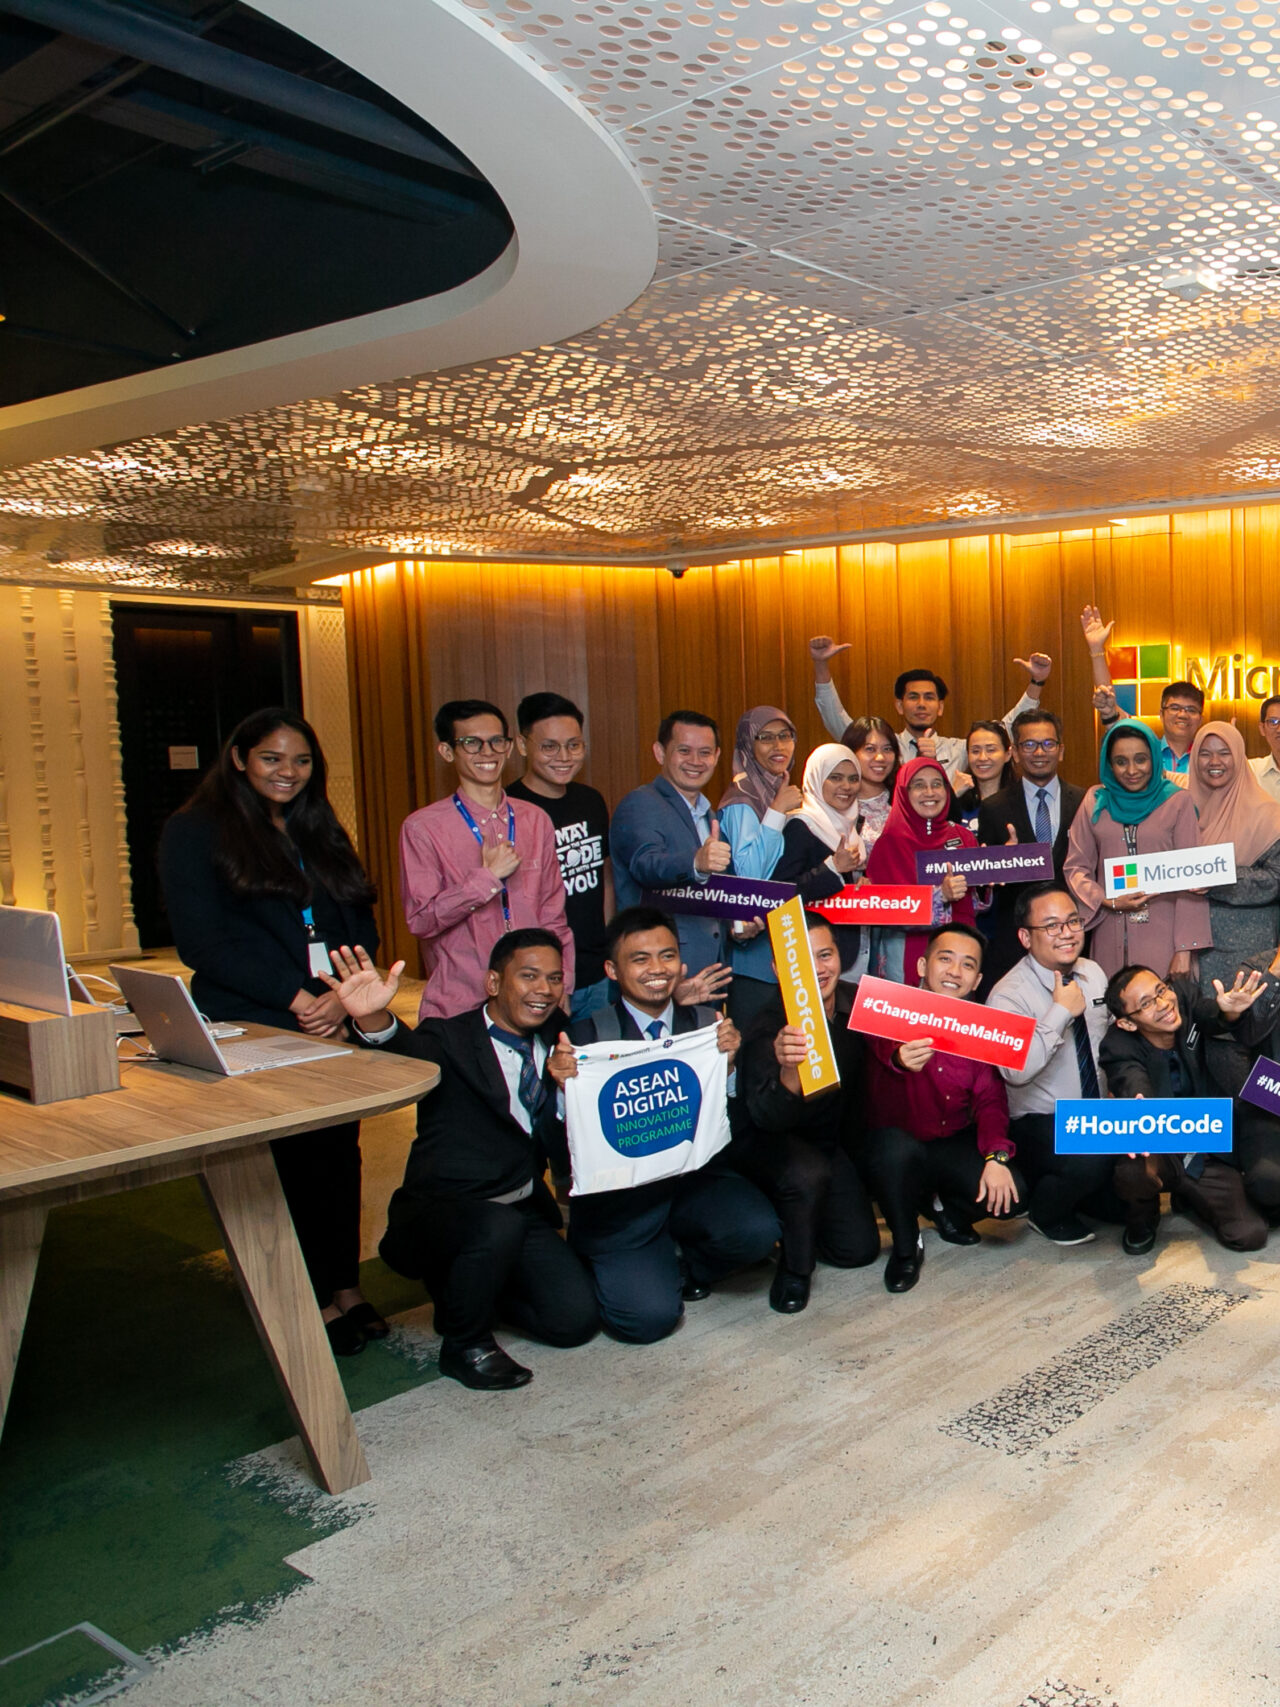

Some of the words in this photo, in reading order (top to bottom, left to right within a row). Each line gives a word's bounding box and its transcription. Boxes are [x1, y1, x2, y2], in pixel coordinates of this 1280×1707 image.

[555, 821, 588, 846] MAY
[563, 870, 598, 896] YOU
[1144, 856, 1228, 882] Microsoft
[780, 914, 823, 1079] #HourOfCode
[863, 997, 1024, 1051] #ChangeInTheMaking
[615, 1067, 680, 1099] ASEAN
[613, 1086, 689, 1119] DIGITAL
[616, 1104, 690, 1133] INNOVATION
[618, 1118, 693, 1149] PROGRAMME
[1065, 1114, 1223, 1135] #HourOfCode
